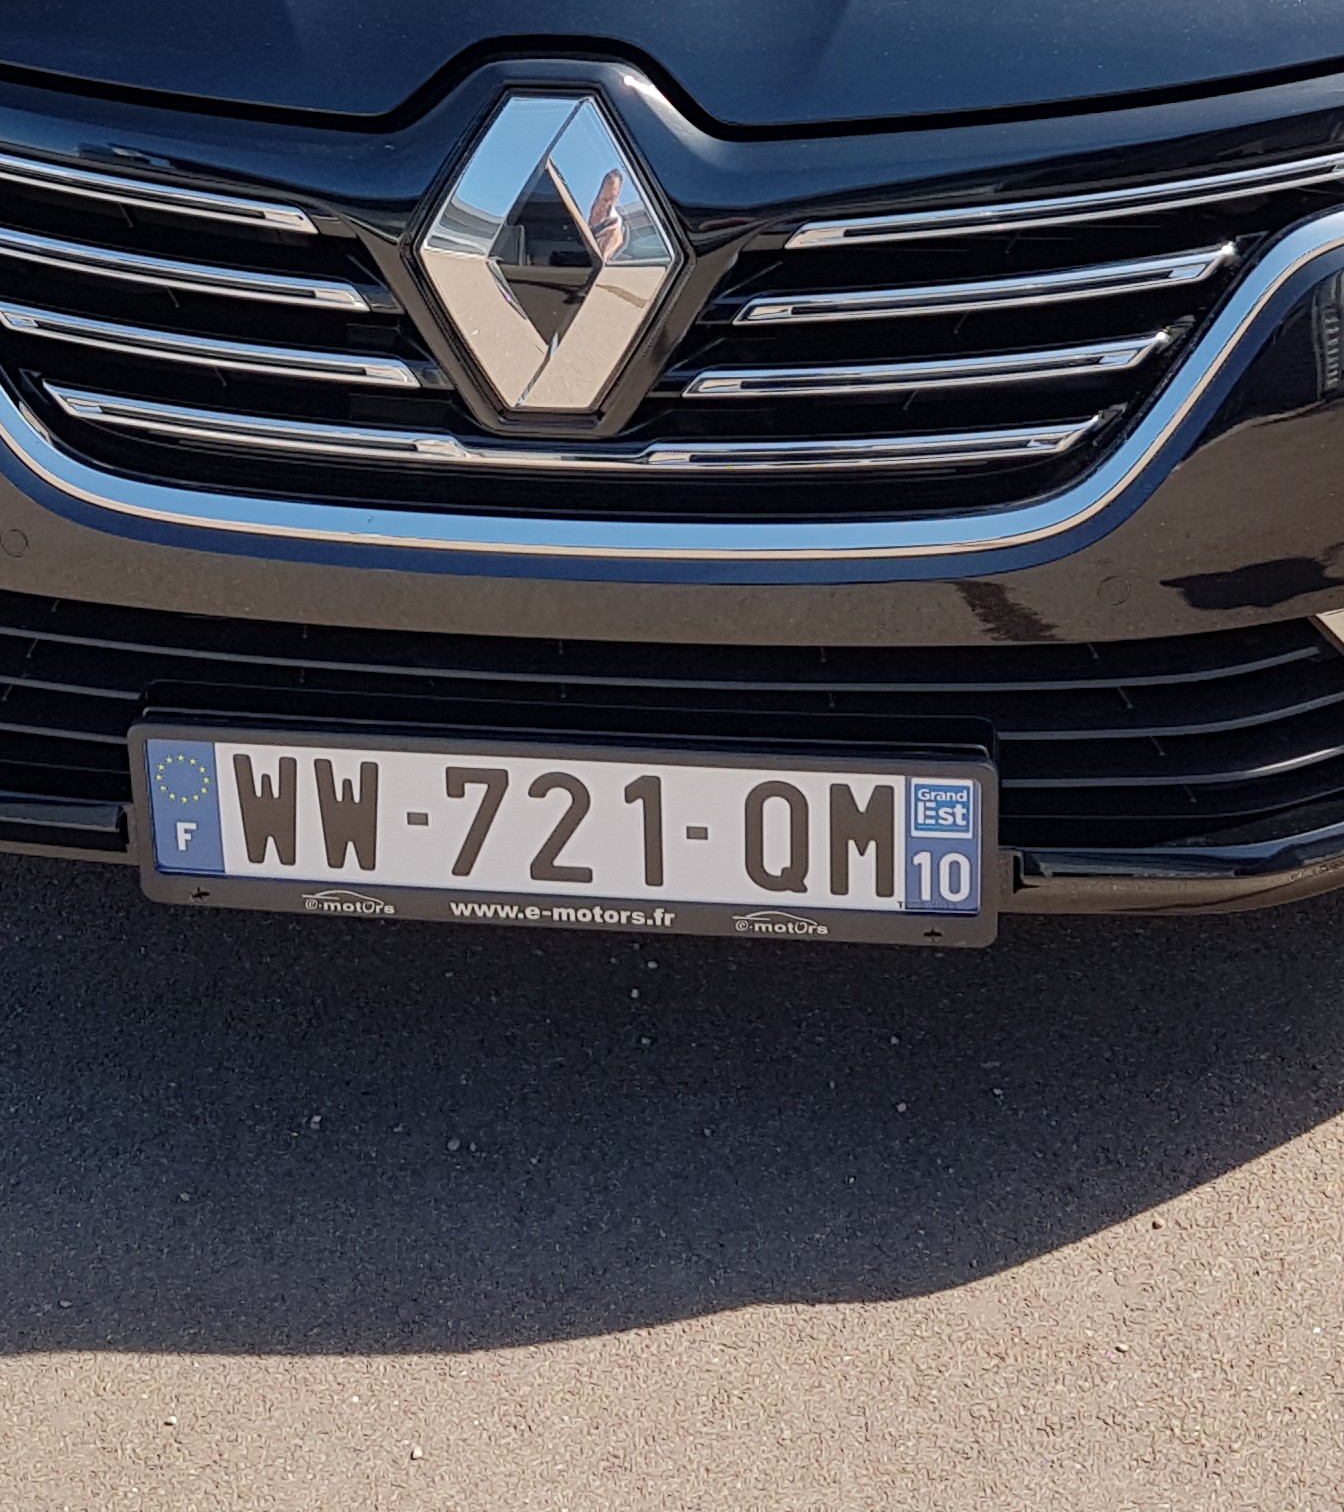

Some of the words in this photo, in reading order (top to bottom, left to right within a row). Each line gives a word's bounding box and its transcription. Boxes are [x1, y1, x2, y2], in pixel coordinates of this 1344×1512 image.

[917, 788, 968, 803] Grand
[232, 753, 896, 898] WW-721-QM
[916, 801, 968, 826] Est
[176, 821, 198, 851] F
[912, 850, 972, 903] 10
[449, 901, 676, 928] www.e-motors.fr
